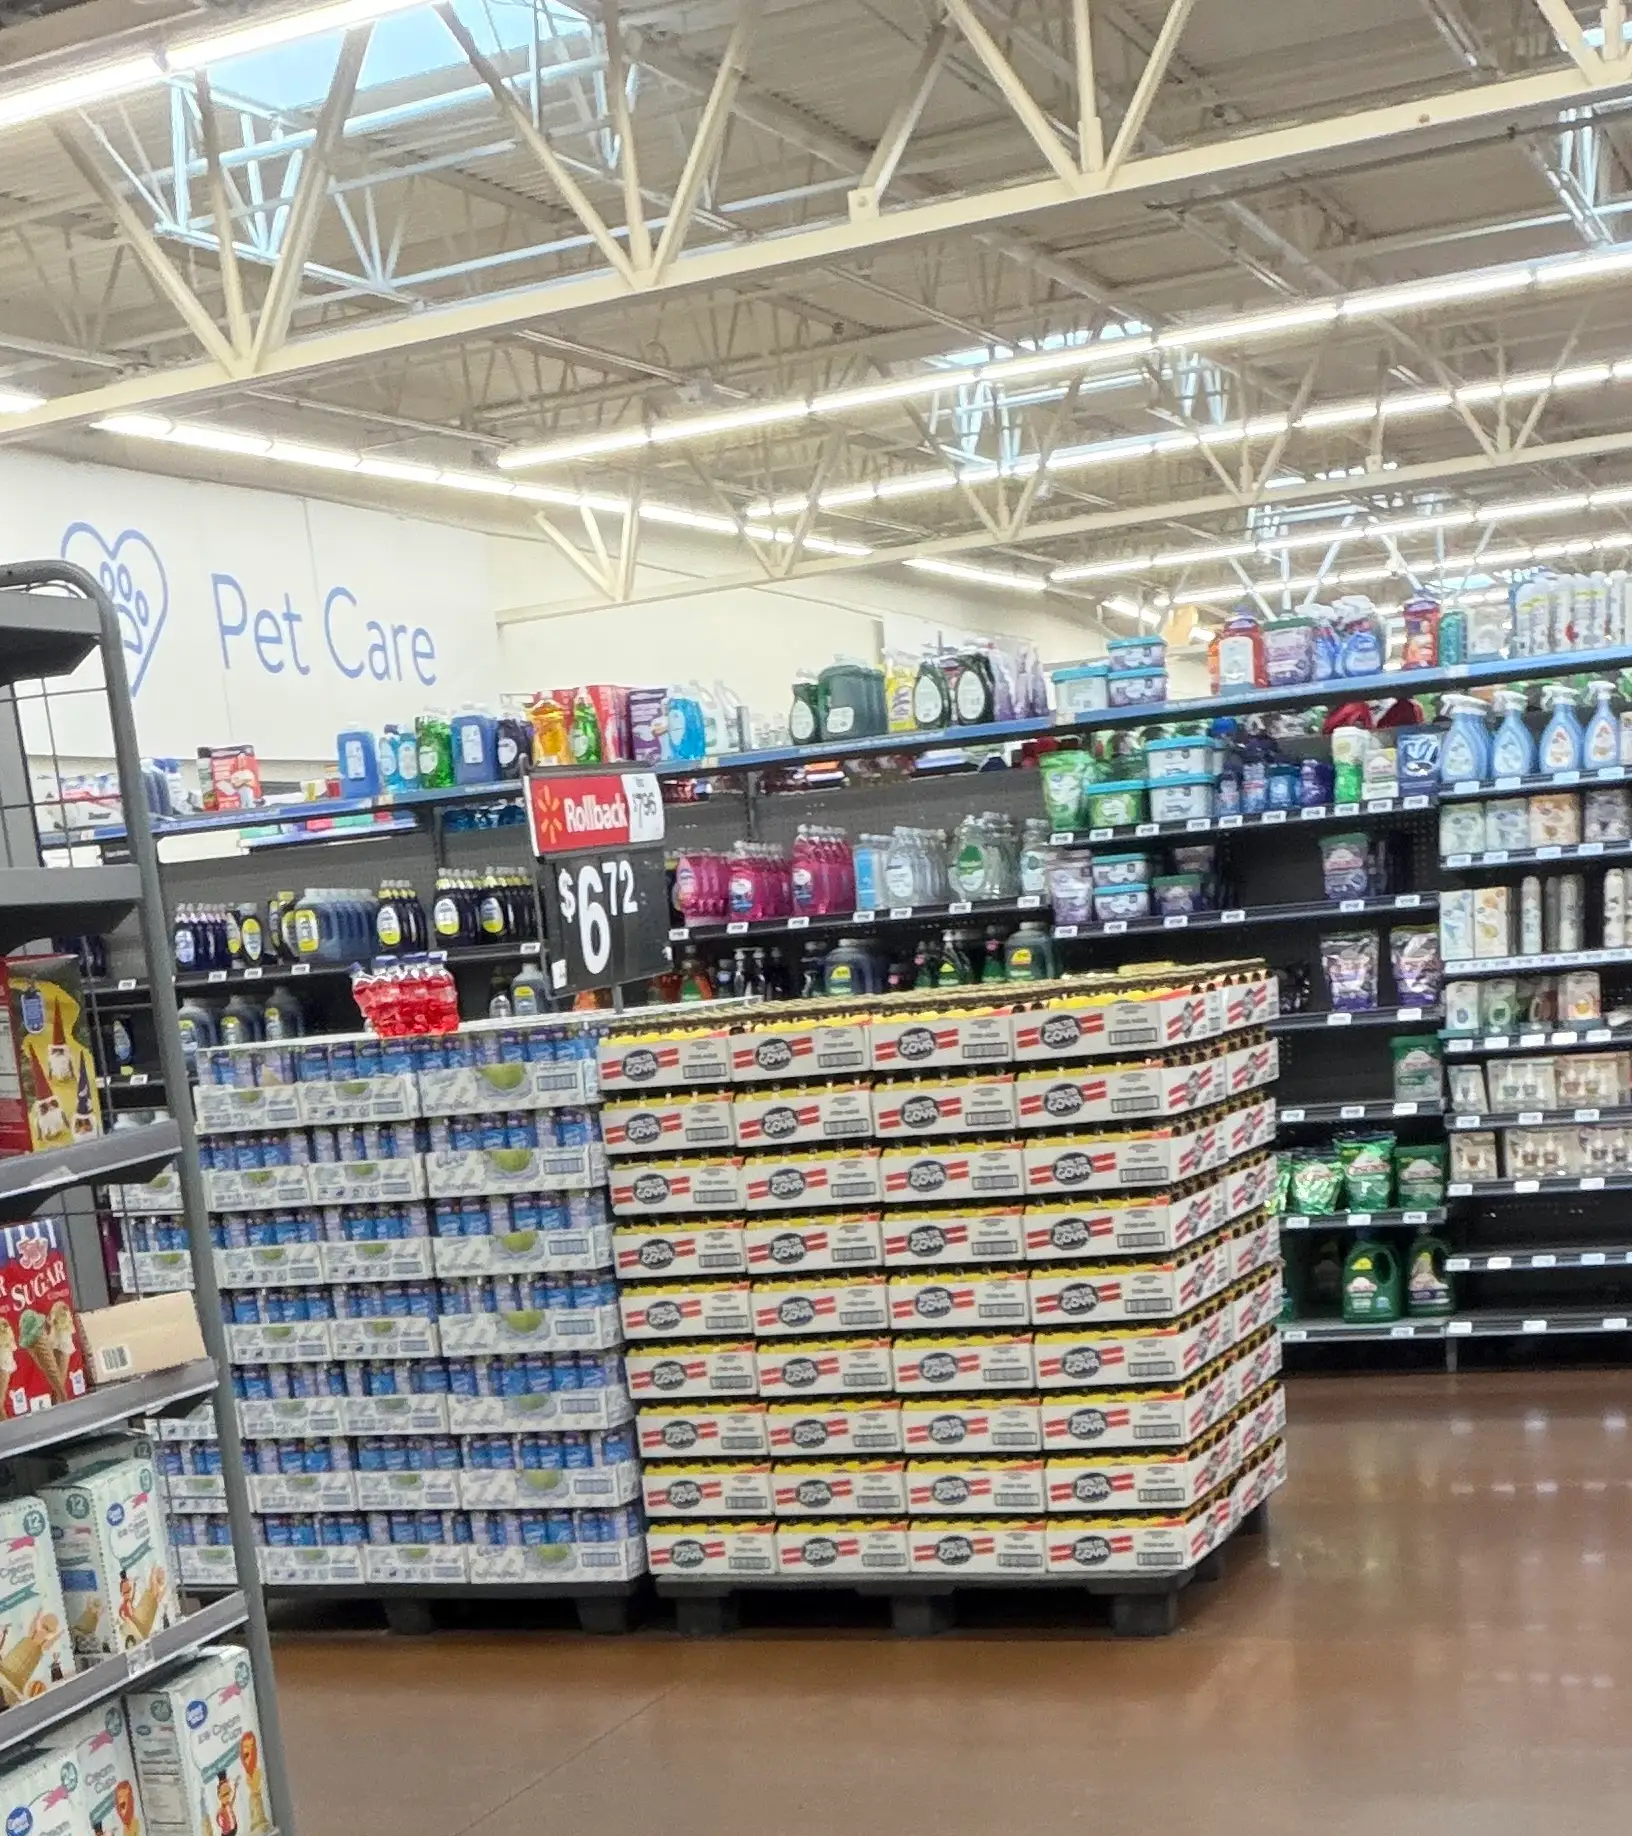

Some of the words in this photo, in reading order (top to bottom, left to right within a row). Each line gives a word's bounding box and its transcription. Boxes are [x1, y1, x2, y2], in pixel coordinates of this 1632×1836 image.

[211, 573, 311, 675] Pet
[324, 587, 436, 686] Care
[564, 794, 628, 832] Rollback
[11, 1261, 66, 1311] SUGAR
[27, 1513, 42, 1527] 12
